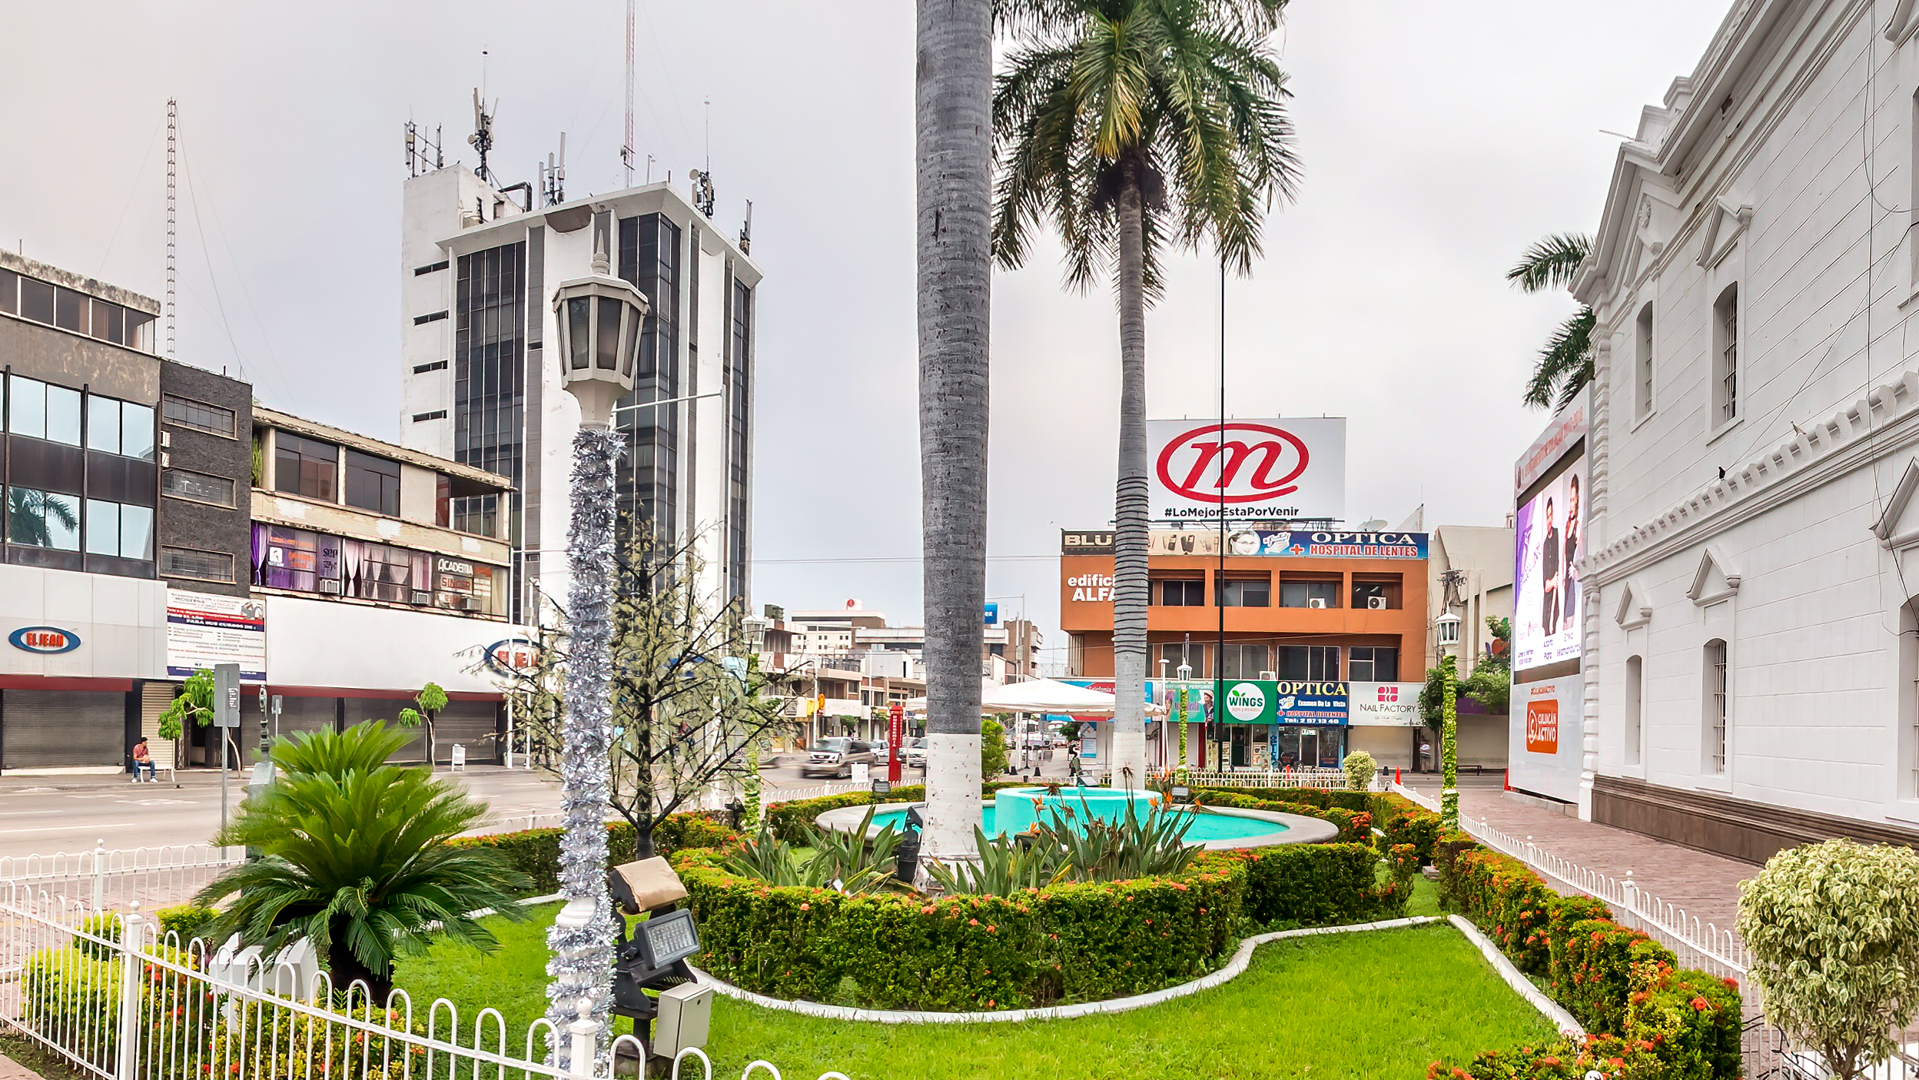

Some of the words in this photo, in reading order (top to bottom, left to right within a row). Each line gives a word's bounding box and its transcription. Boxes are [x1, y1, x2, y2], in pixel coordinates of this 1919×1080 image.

[1164, 506, 1300, 518] #LoMejorEstaPorVenir
[1064, 534, 1112, 546] BLU
[1311, 532, 1416, 545] OPTICA
[1310, 544, 1362, 556] HOSPITAL
[1364, 545, 1377, 556] DE
[1380, 546, 1418, 557] LENTES
[441, 577, 471, 590] SINGER
[1072, 588, 1116, 602] ALFA
[26, 632, 38, 646] EL
[38, 634, 64, 647] JEAN
[1277, 682, 1348, 696] OPTICA
[1229, 696, 1264, 707] WINGS
[1360, 704, 1378, 712] NAIL
[1380, 704, 1416, 713] FACTORY
[1538, 727, 1556, 742] ACTIVO
